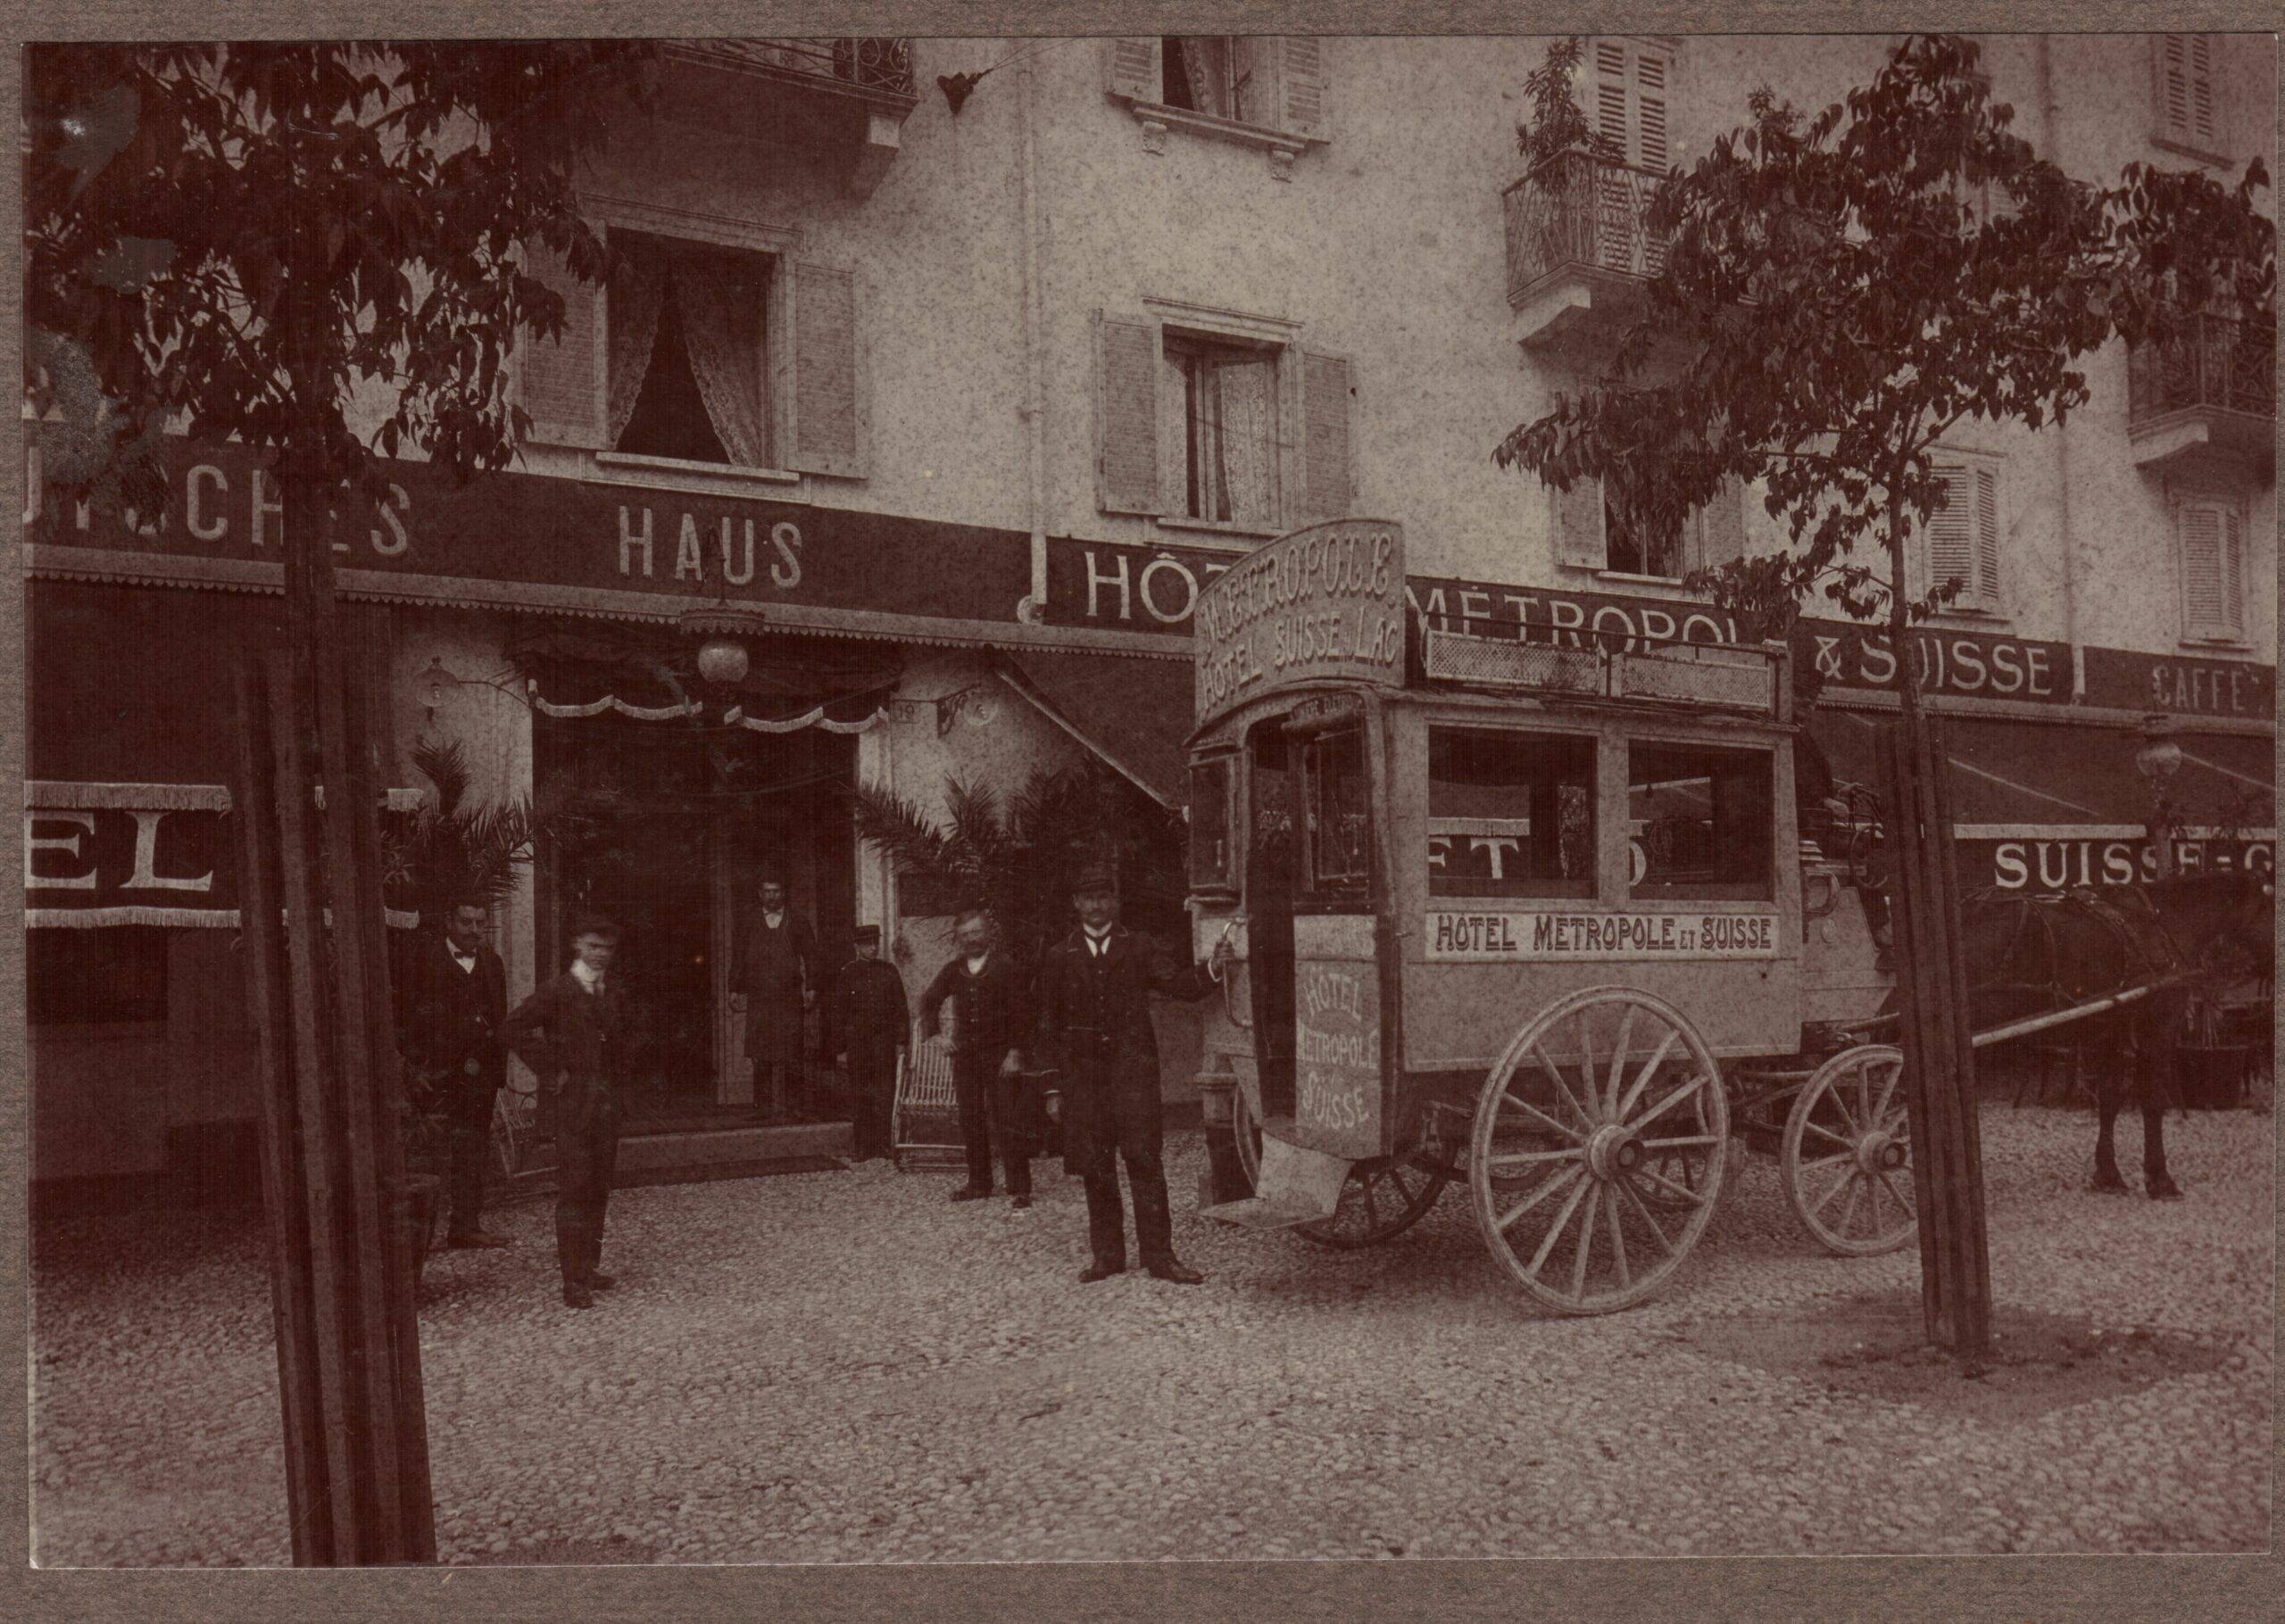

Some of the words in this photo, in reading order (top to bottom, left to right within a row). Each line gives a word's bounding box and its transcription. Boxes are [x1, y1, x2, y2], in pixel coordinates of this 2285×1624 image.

[619, 506, 802, 587] HAUS
[1274, 610, 1340, 671] SUISSE
[1354, 607, 1398, 667] LAC
[1435, 915, 1517, 951] HOTEL
[1533, 915, 1676, 951] METROPOLE
[1680, 929, 1696, 950] ET
[1700, 916, 1772, 950] SUISSE
